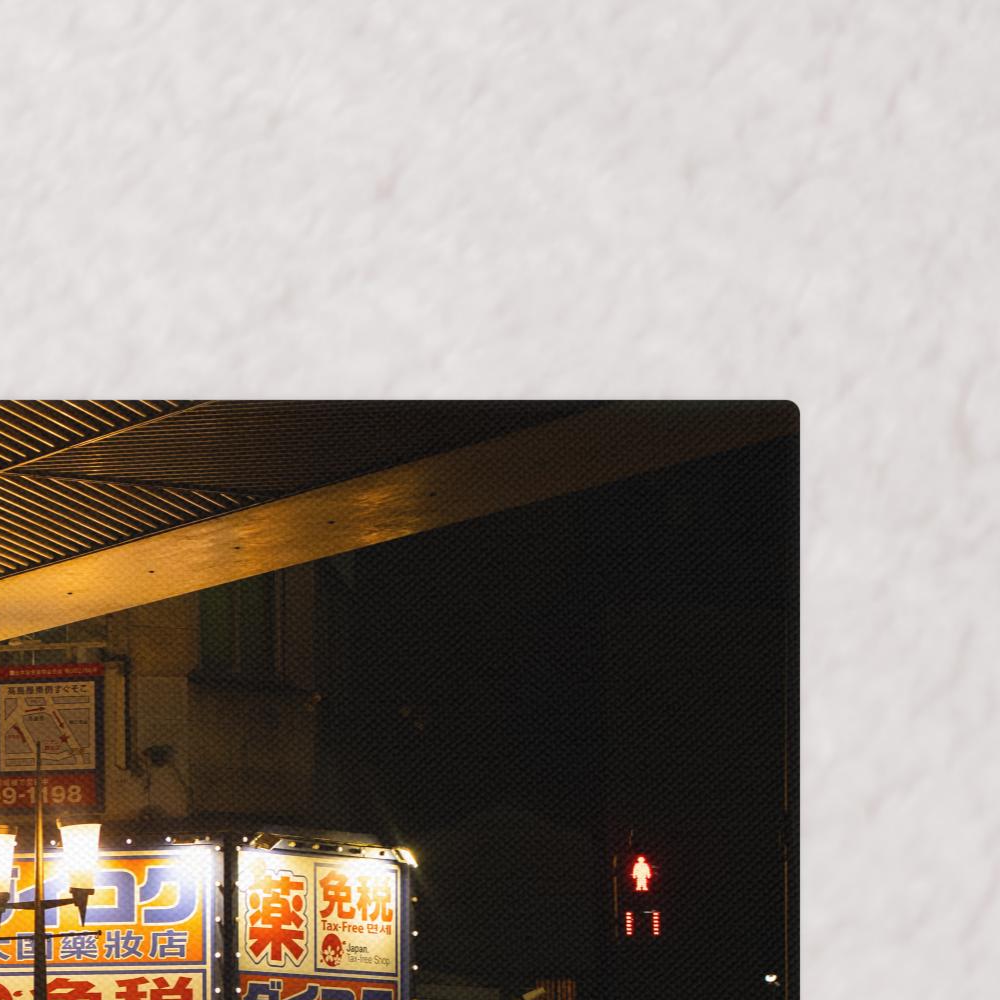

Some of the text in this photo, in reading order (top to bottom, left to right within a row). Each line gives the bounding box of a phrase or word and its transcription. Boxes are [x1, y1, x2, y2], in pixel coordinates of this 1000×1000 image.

[249, 875, 305, 962] 薬
[319, 871, 394, 923] 免税
[321, 919, 364, 934] Tax-Free
